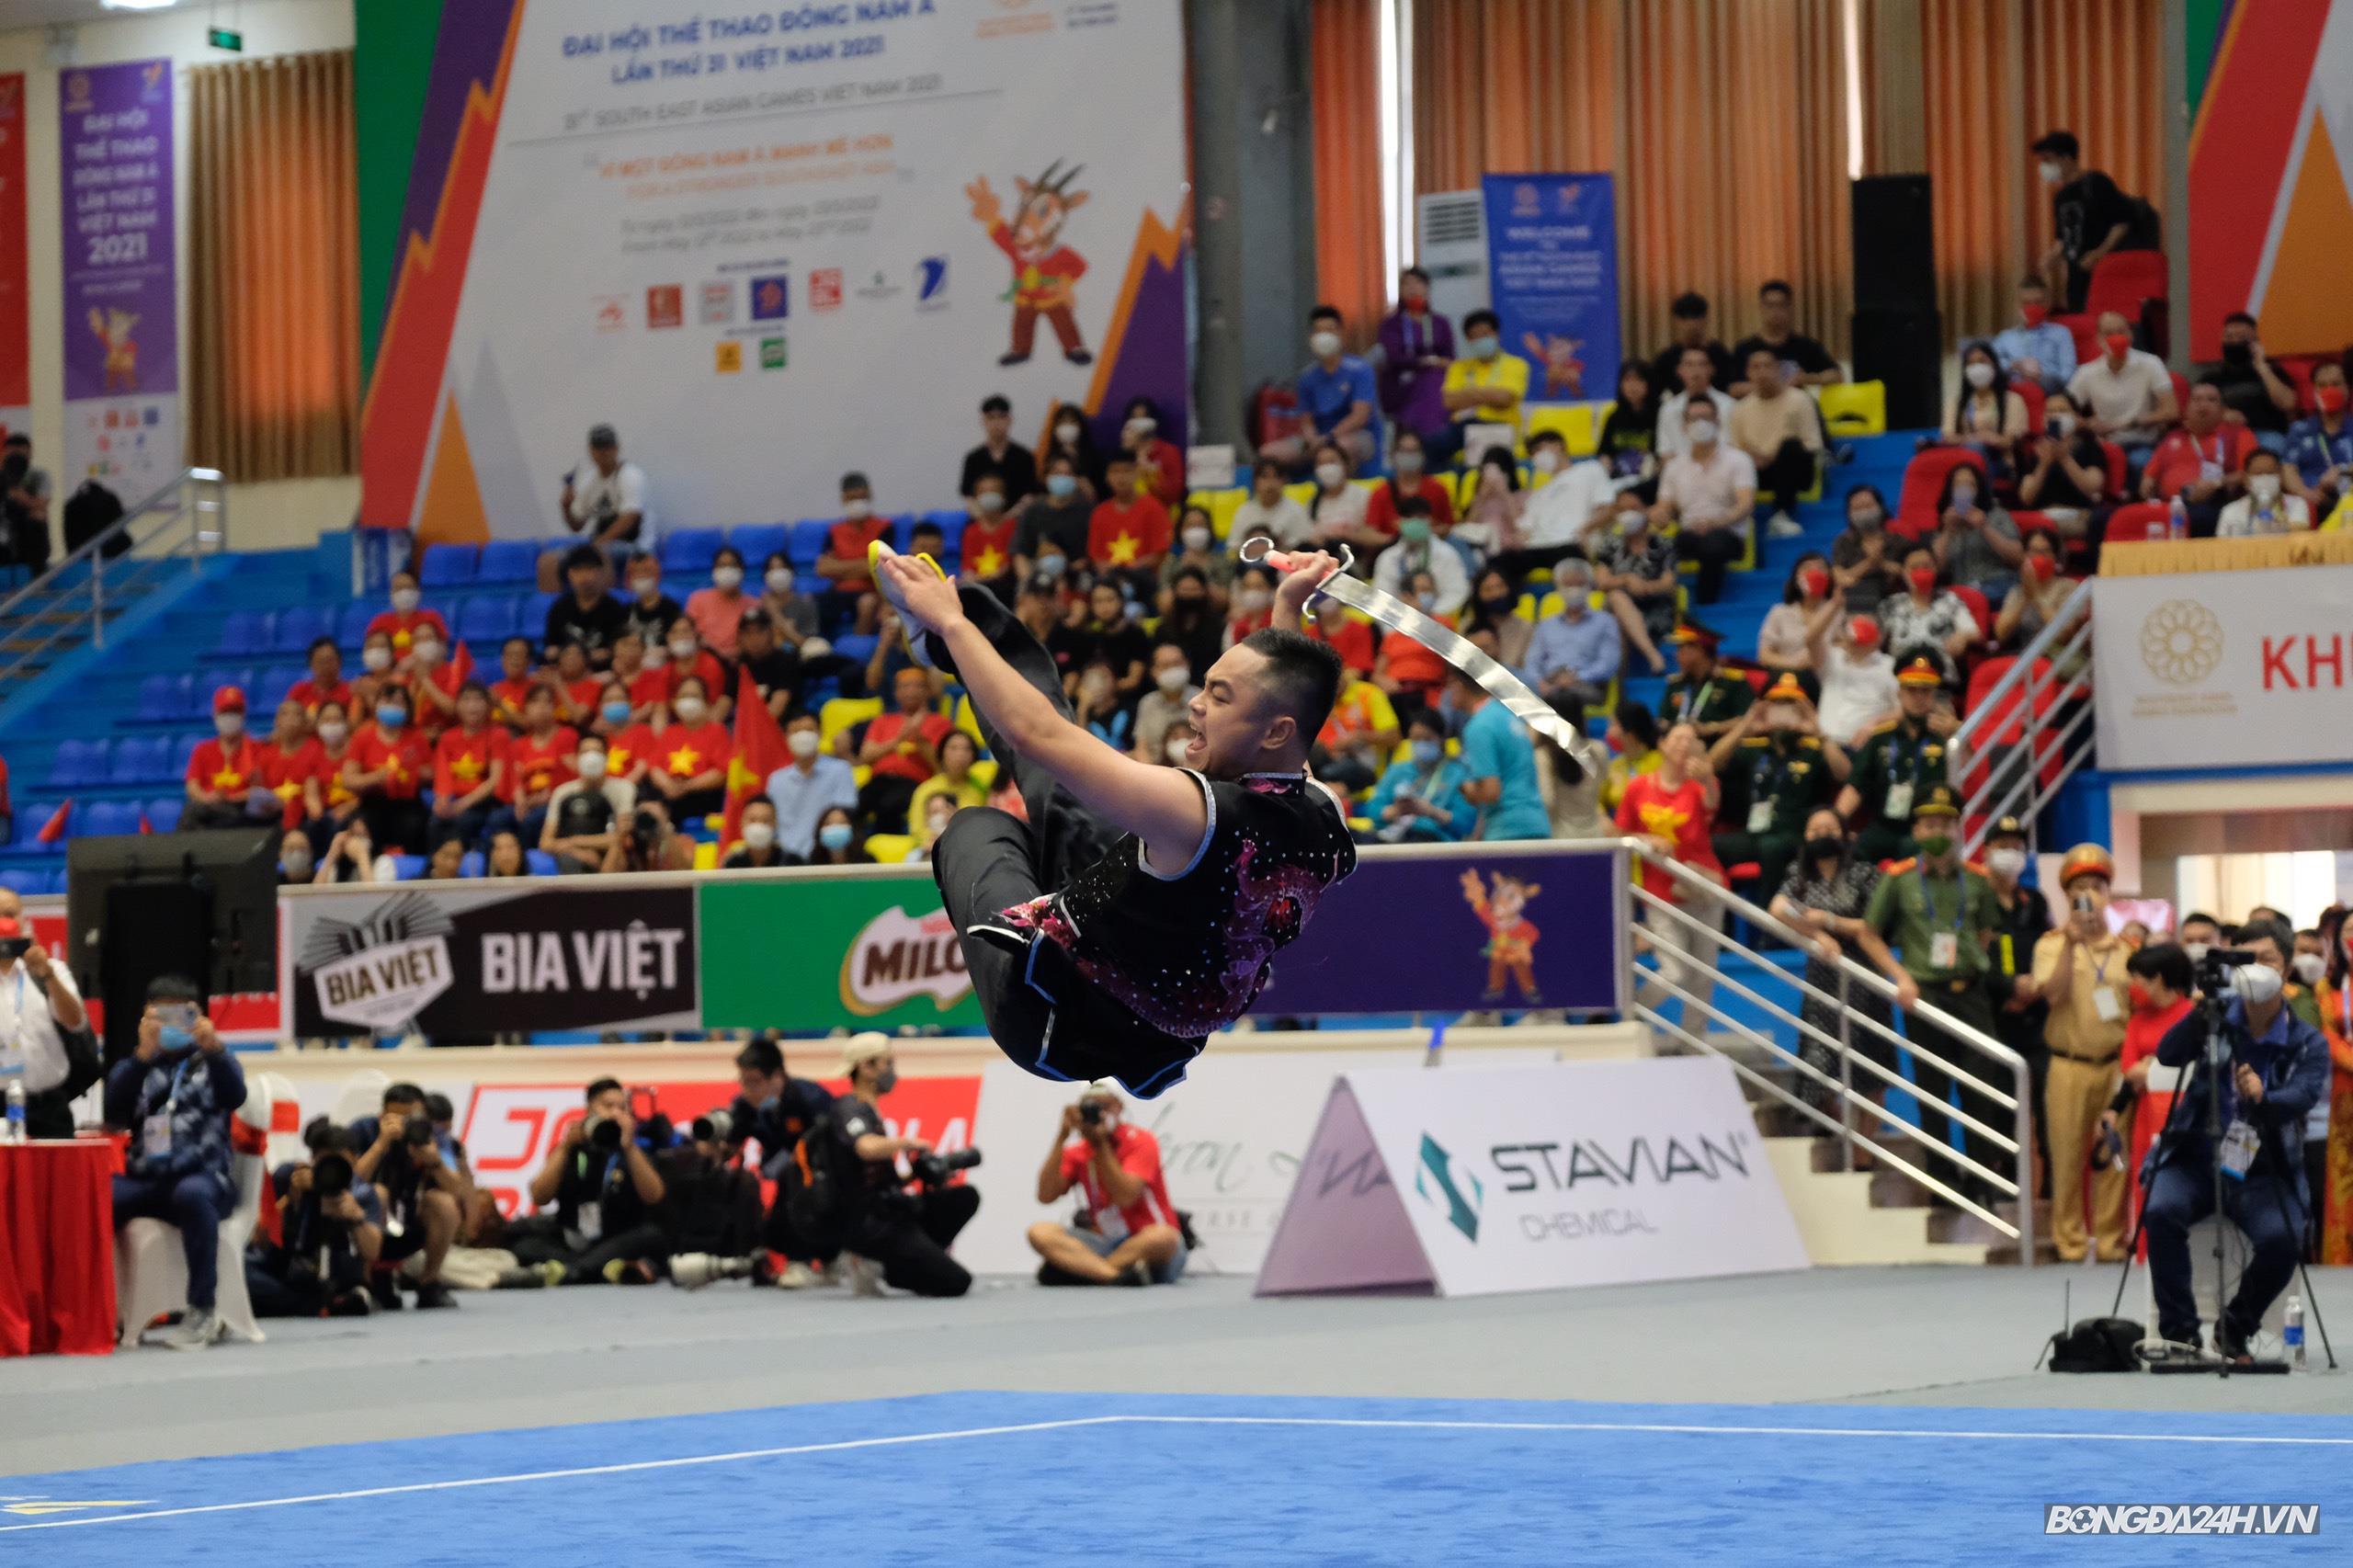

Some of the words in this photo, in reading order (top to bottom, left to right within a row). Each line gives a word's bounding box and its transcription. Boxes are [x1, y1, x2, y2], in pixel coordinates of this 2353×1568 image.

[709, 13, 773, 40] THAO
[87, 233, 149, 267] 2021
[2262, 632, 2353, 691] KH
[325, 971, 375, 1008] BIA
[376, 942, 439, 988] VIỆT
[482, 931, 569, 994] BIA
[573, 919, 685, 1001] VIỆT
[1518, 1208, 1659, 1242] CHEMICAL
